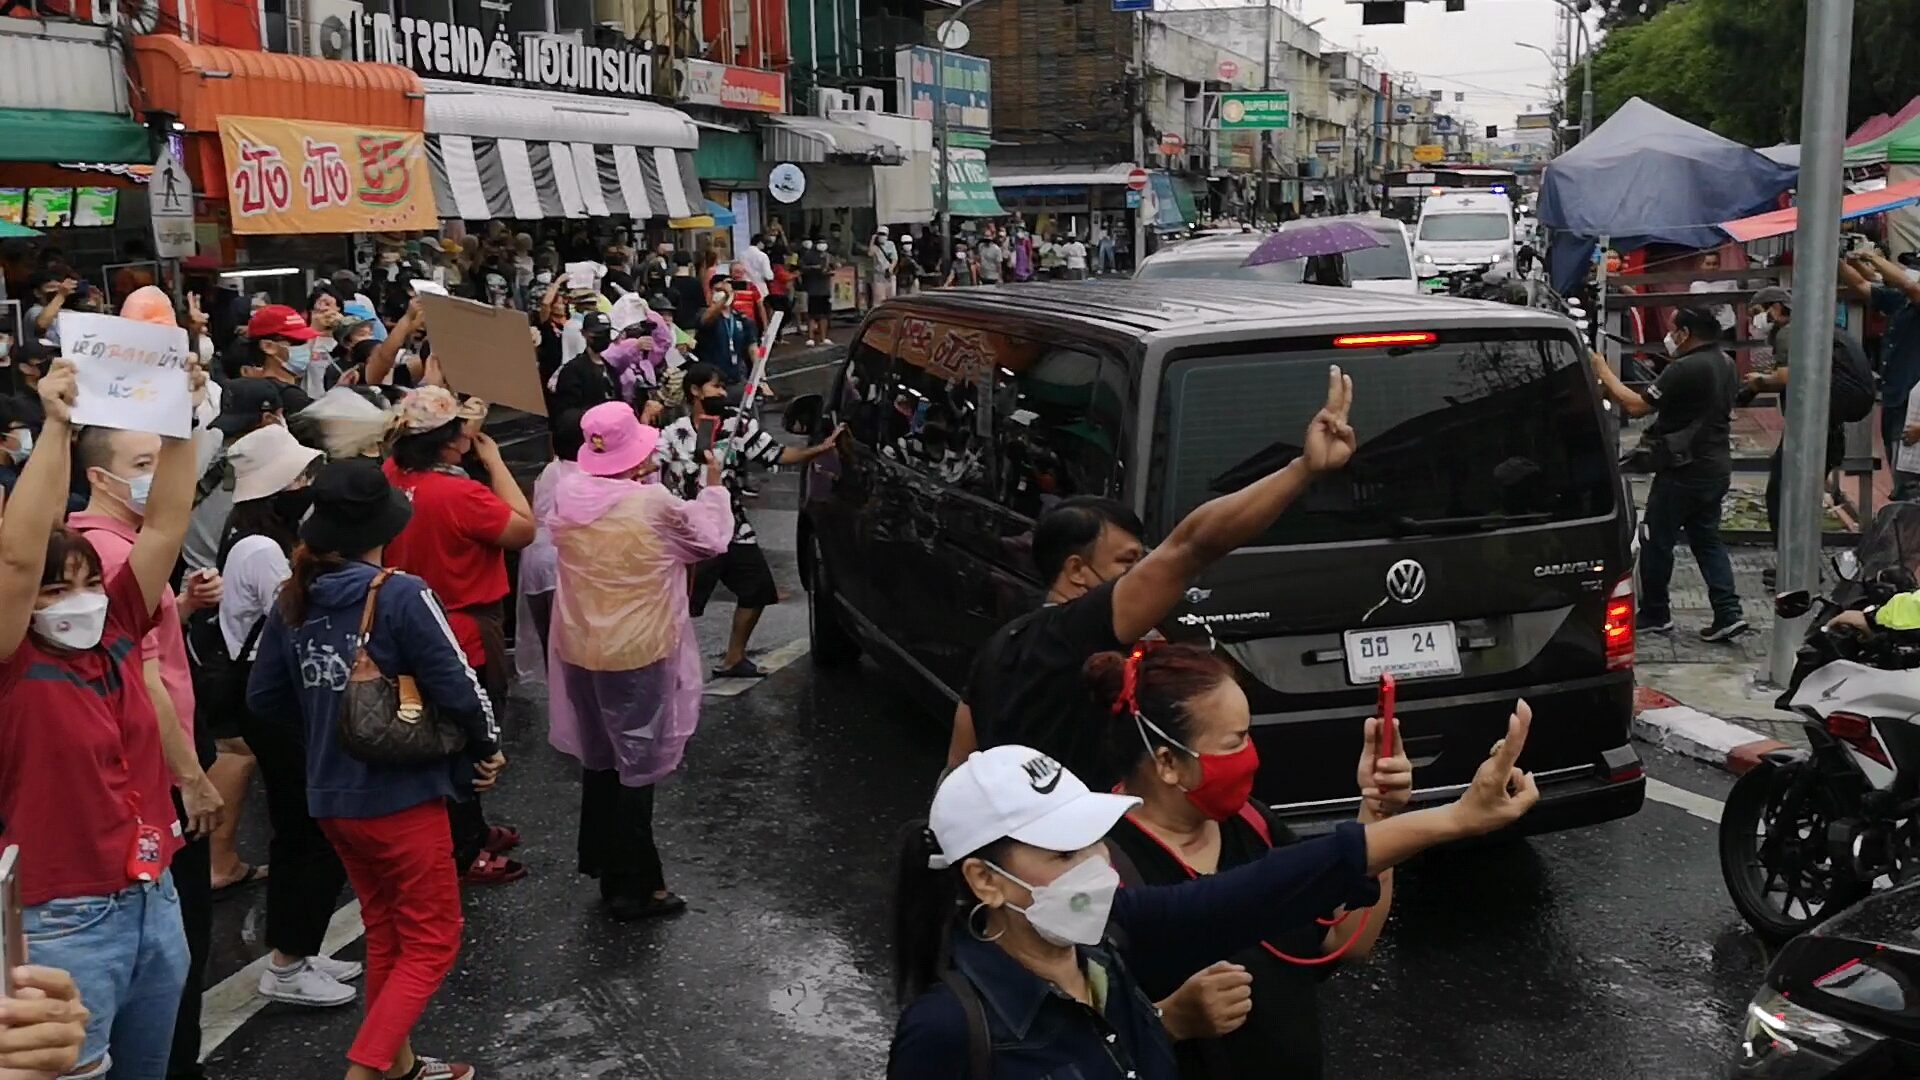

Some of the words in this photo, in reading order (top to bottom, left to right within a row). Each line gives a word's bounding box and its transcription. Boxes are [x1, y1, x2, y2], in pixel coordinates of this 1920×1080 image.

[400, 16, 485, 76] TREND
[234, 140, 291, 215] ปัง
[303, 137, 349, 208] ปัง
[1412, 631, 1435, 653] 24
